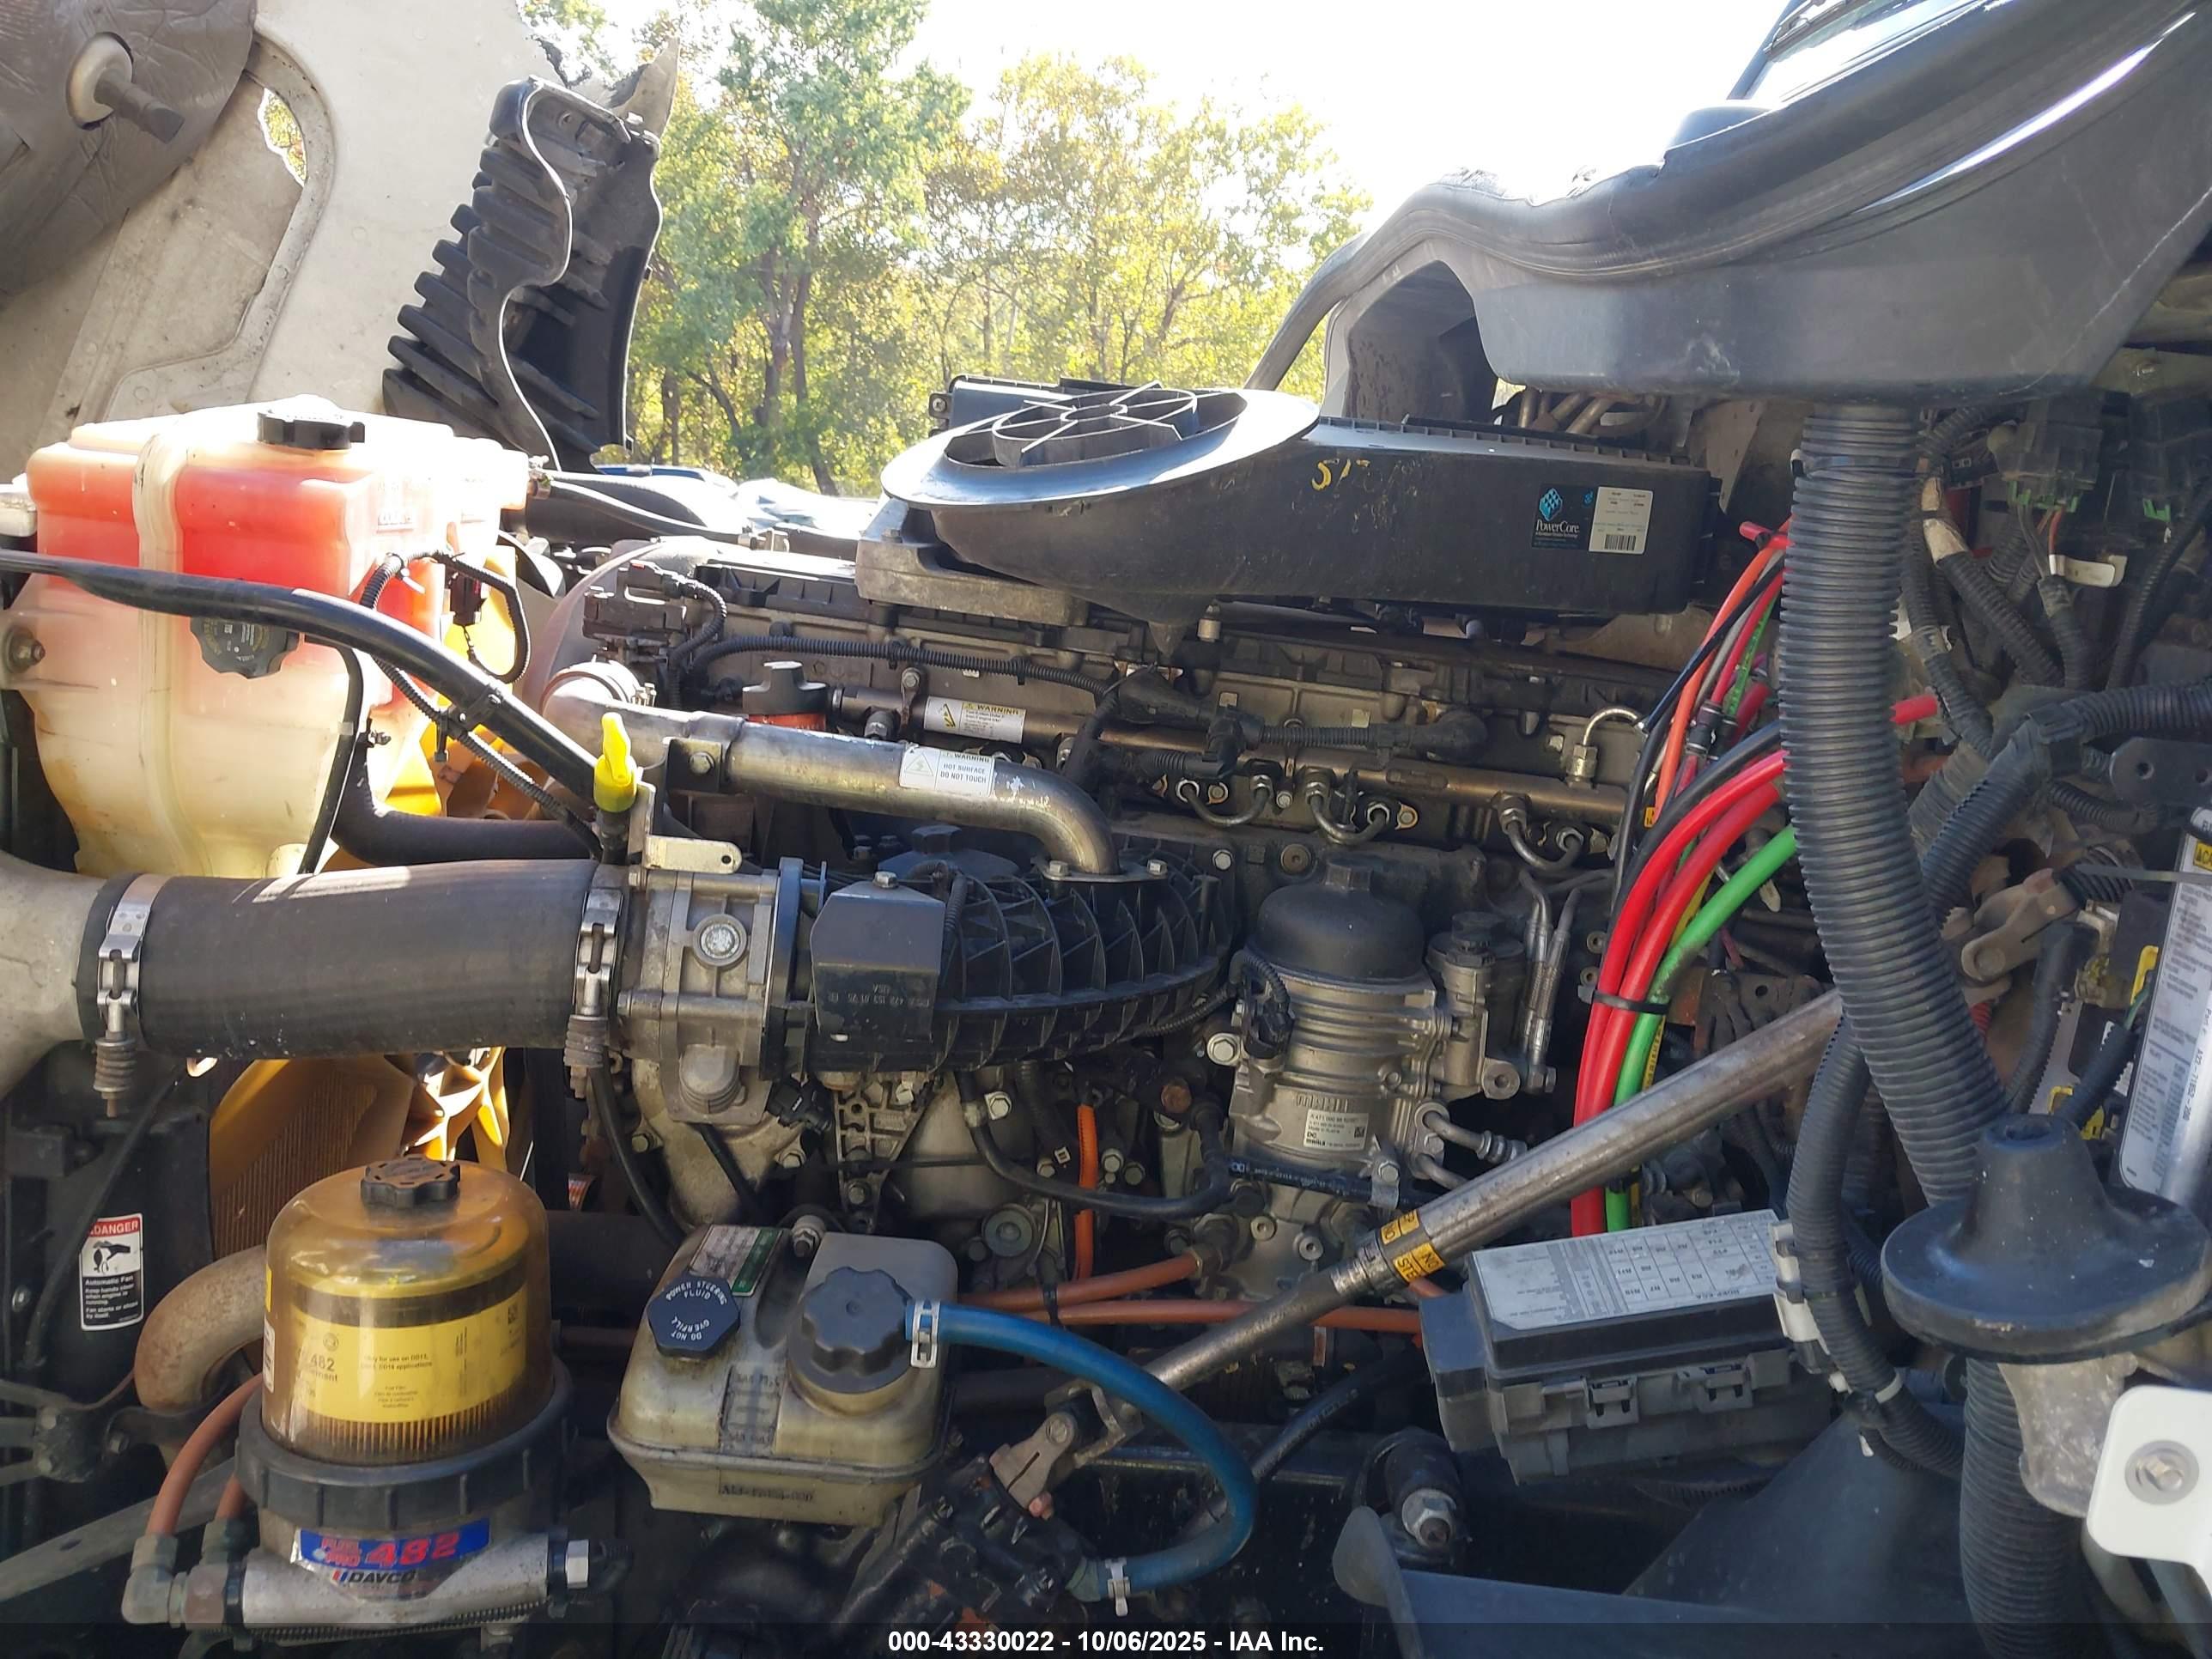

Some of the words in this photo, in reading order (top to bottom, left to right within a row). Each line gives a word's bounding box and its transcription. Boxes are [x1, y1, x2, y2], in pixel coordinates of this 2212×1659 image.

[1535, 519, 1580, 533] PowerCore
[977, 704, 1019, 714] WARNING
[954, 754, 989, 763] WARNING
[957, 765, 986, 774] SURFACE
[965, 775, 987, 783] TOUCH
[94, 1220, 138, 1235] DANGER
[86, 1278, 118, 1286] Automatic
[120, 1275, 134, 1284] Fan
[665, 1281, 692, 1302] POWER
[696, 1280, 728, 1306] STEERING
[684, 1290, 711, 1300] FLUID
[672, 1316, 710, 1333] OVERFILL
[671, 1329, 687, 1341] NOT
[690, 1331, 702, 1341] DO
[311, 1353, 335, 1372] 482
[365, 1531, 460, 1567] 482
[349, 1570, 416, 1584] DAVCO
